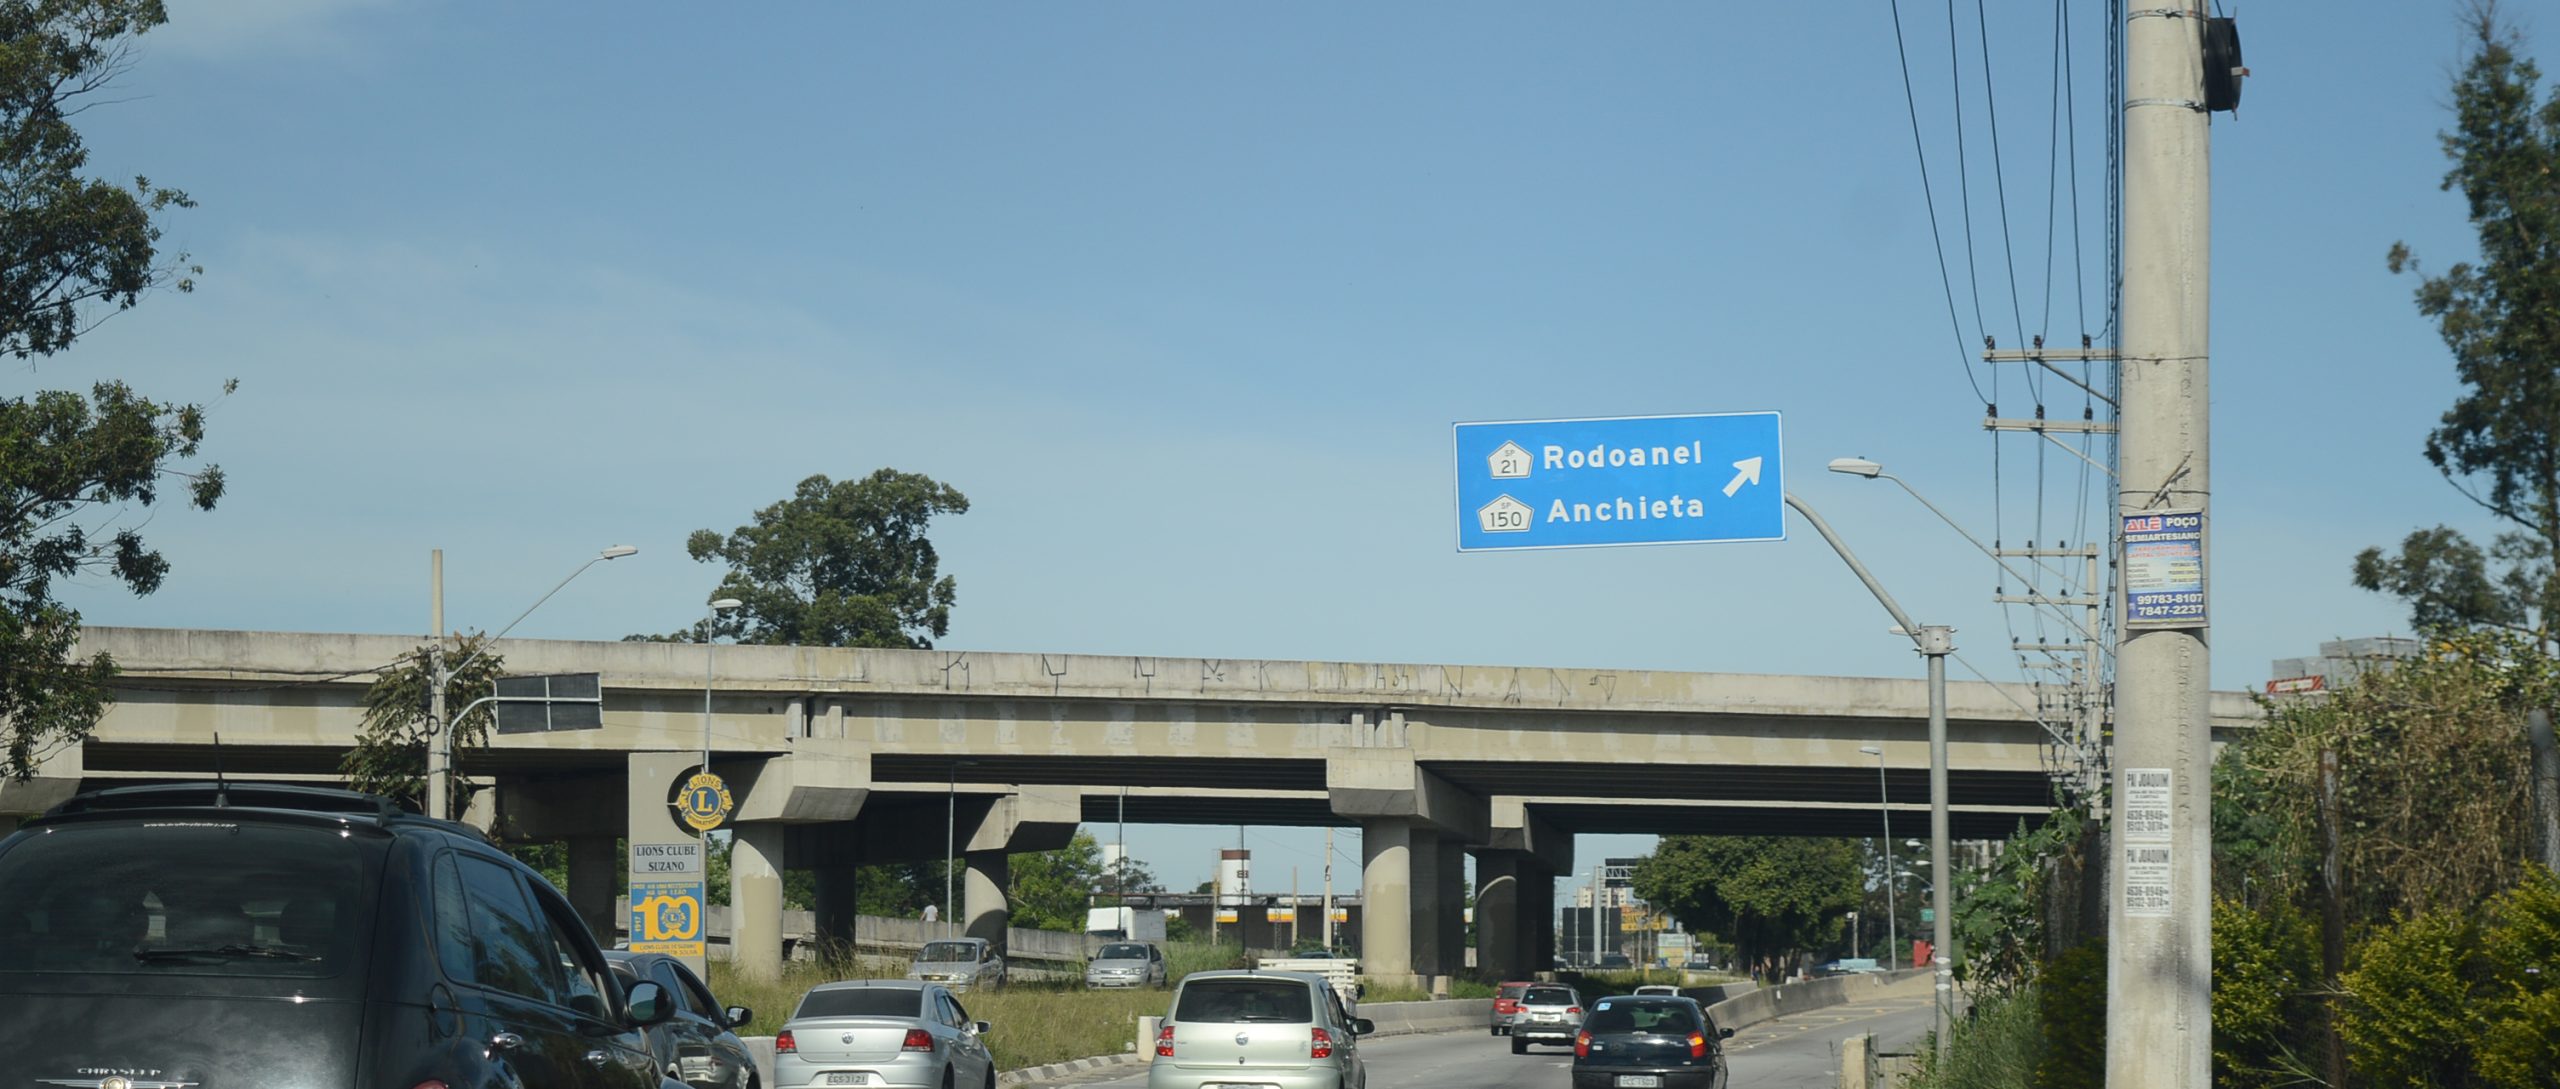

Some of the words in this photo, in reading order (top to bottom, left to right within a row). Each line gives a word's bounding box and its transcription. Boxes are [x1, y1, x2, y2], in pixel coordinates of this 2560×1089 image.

[1543, 441, 1702, 470] Rodoanel
[1500, 460, 1517, 473] 21
[1546, 495, 1704, 523] Anchieta
[1489, 511, 1522, 527] 150
[2166, 517, 2198, 528] POÇO
[2125, 532, 2200, 542] SEMIARTESIANO
[2137, 593, 2203, 605] 99783-8107
[2138, 605, 2203, 616] 7847-2237
[691, 775, 721, 788] LIONS
[696, 790, 713, 812] L
[636, 846, 664, 857] LIONS
[666, 846, 696, 856] CLUBE
[648, 861, 685, 872] SUZANO
[632, 895, 699, 941] 100
